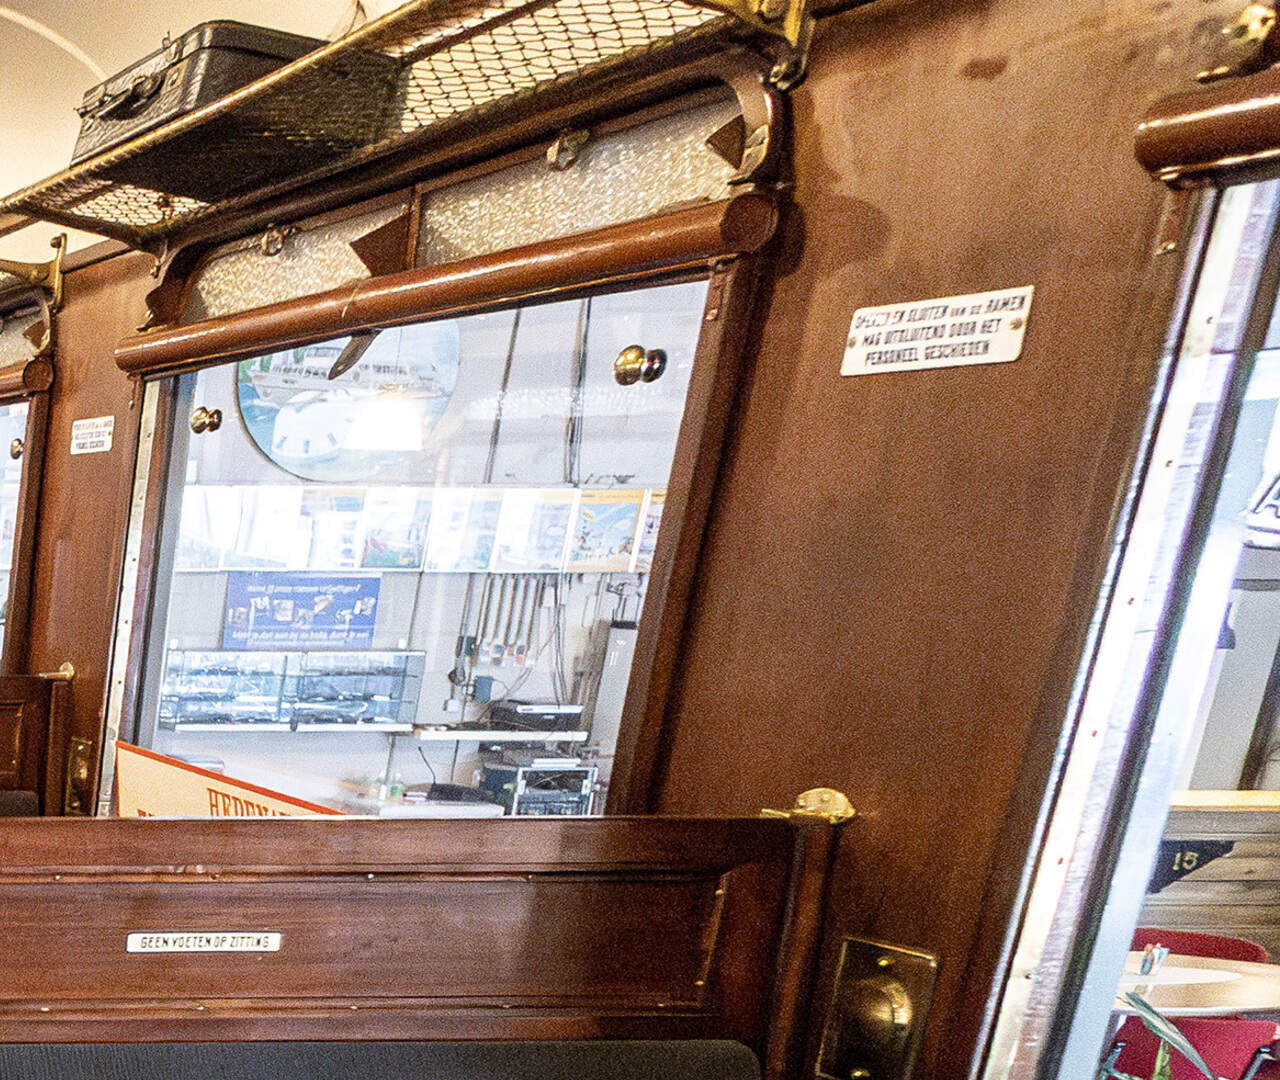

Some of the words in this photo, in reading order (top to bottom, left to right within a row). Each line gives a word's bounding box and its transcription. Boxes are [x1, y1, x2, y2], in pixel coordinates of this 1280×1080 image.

[984, 295, 1027, 314] RAMEN
[862, 332, 882, 348] MAG
[865, 347, 918, 366] PERSONEEL
[924, 340, 990, 361] GESCHIEDEN
[140, 936, 170, 949] GEEN
[172, 936, 211, 949] VOETEN
[214, 936, 227, 948] OP
[229, 936, 270, 948] ZITTING
